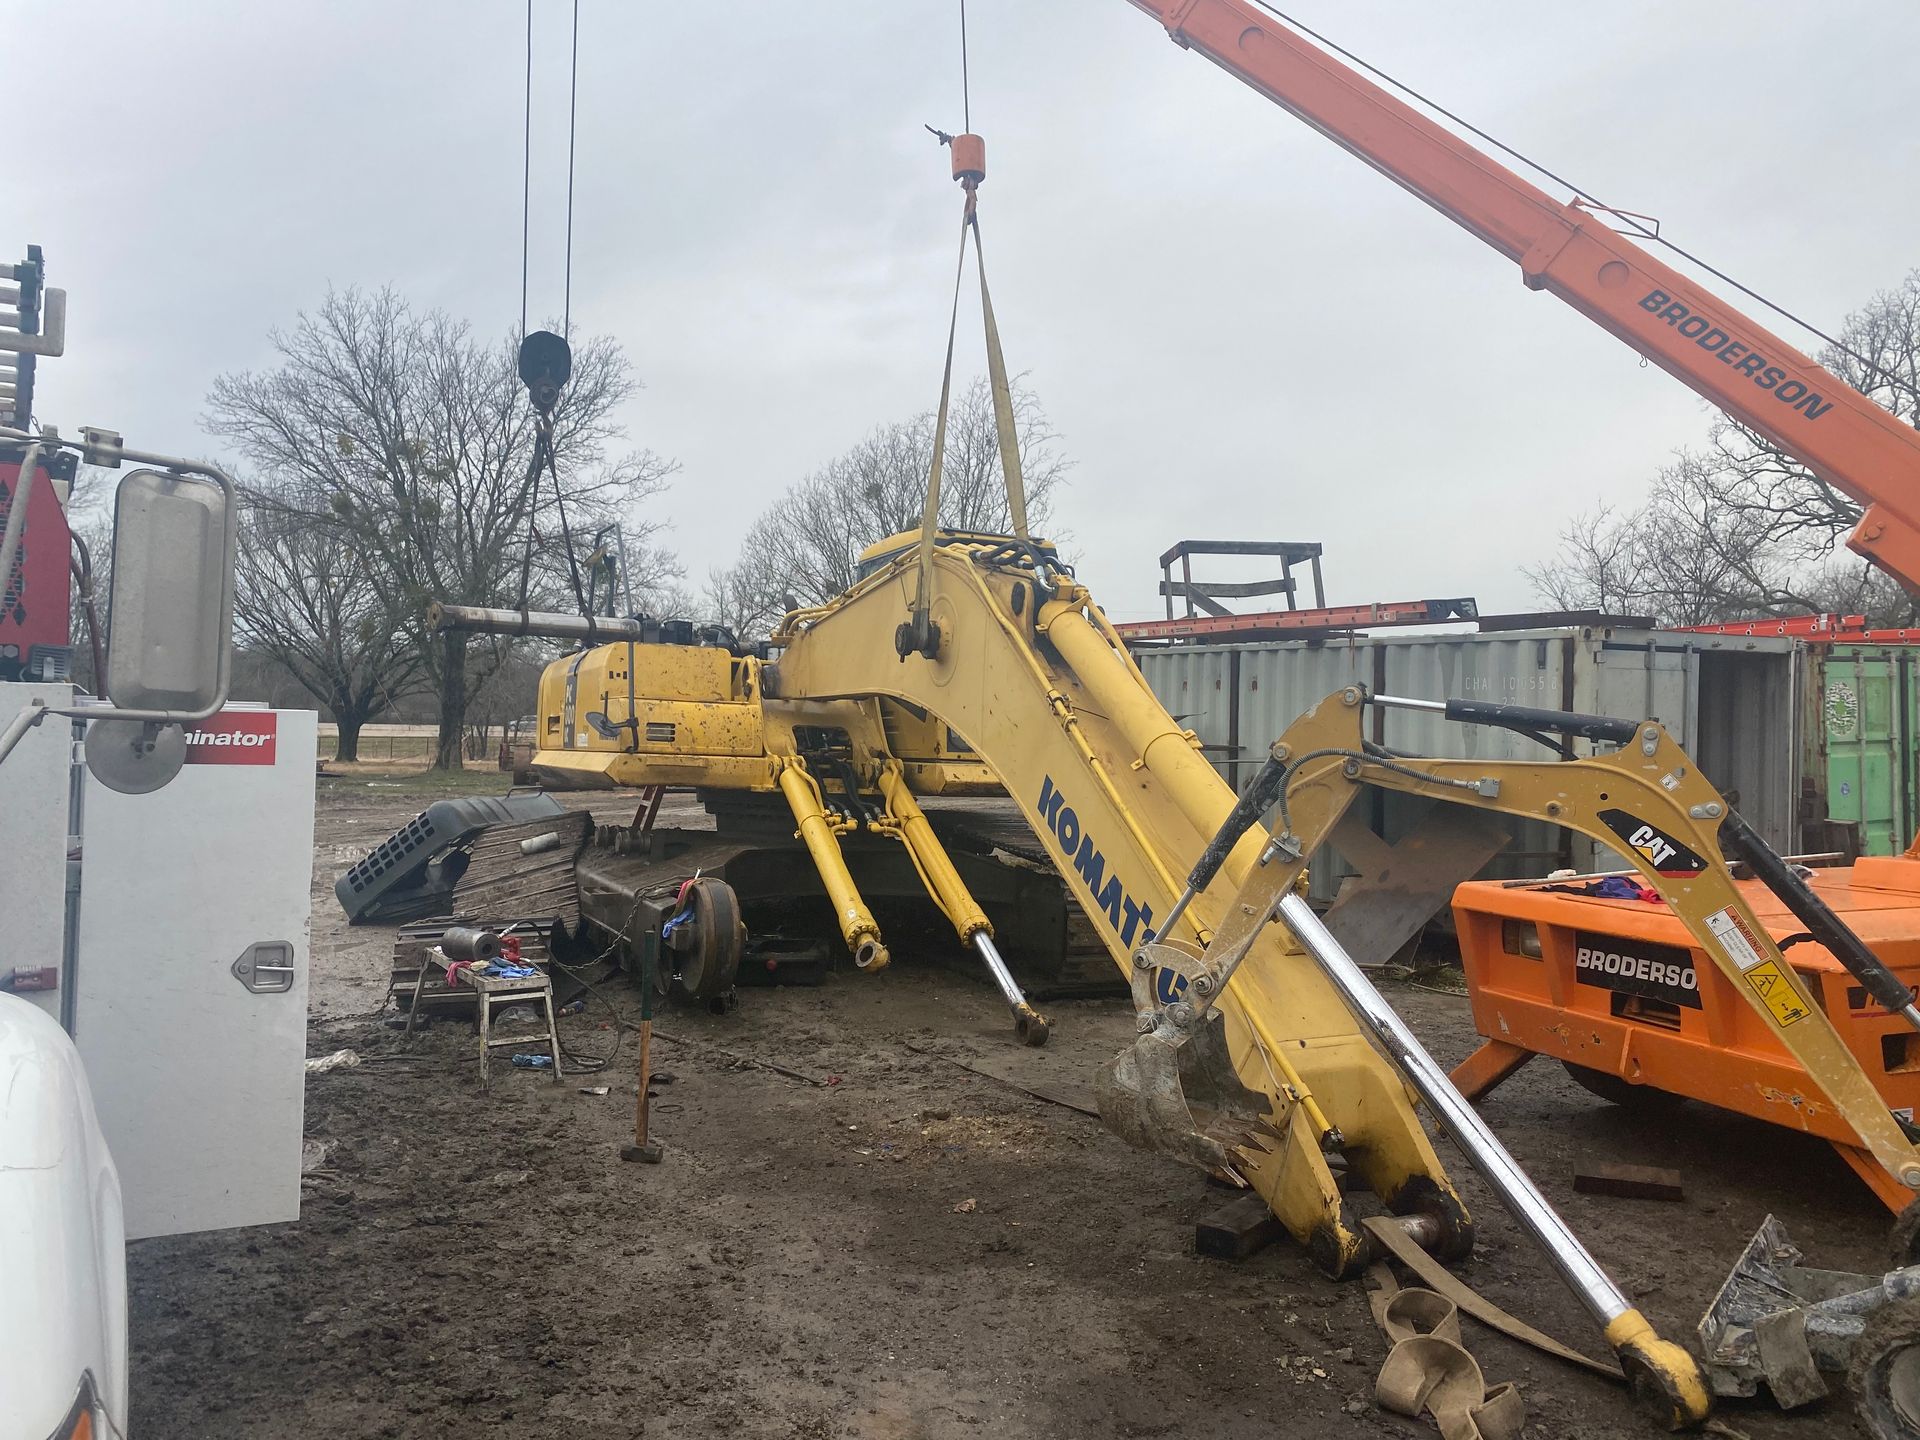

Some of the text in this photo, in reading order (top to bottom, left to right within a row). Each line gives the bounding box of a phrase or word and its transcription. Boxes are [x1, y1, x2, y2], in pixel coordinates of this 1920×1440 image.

[1638, 289, 1834, 421] BRODERSON
[1629, 825, 1677, 867] CAT
[1037, 774, 1189, 1004] KOMATU
[1736, 919, 1762, 953] WARNING
[1576, 947, 1700, 992] BRODERSO
